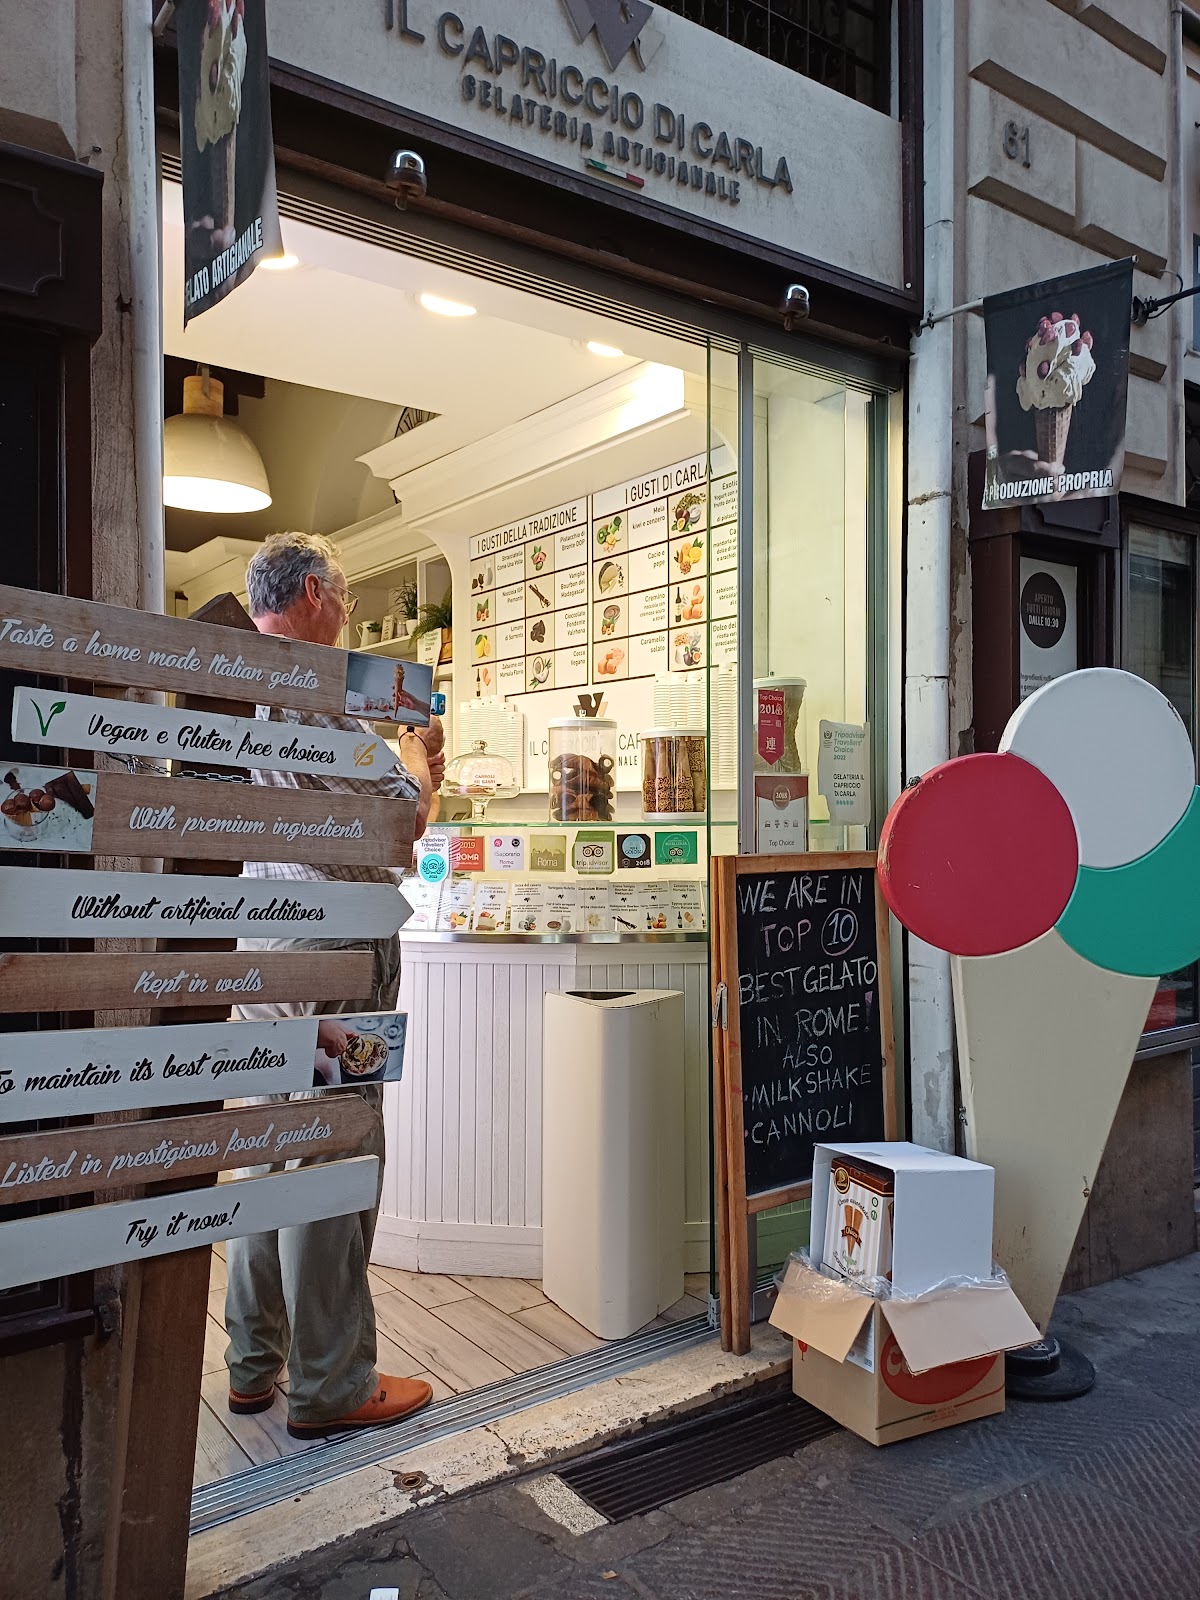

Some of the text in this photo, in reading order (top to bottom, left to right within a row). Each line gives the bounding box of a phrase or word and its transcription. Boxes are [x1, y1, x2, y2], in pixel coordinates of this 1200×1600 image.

[383, 0, 794, 194] IL CAPRICCIO DI CARLA
[462, 74, 741, 204] GELATERIA ARTIGIANALE
[185, 216, 263, 307] ELATO ARTIGIANALE
[630, 478, 659, 502] GUSTI
[662, 472, 673, 492] DI
[675, 462, 713, 486] CARLA
[1058, 469, 1113, 493] PROPRIA
[481, 533, 502, 552] GUSTI
[503, 525, 527, 545] DELLA
[529, 506, 577, 536] TRADIZIONE
[1028, 615, 1044, 626] DALLE
[0, 618, 320, 691] Taste a home made Italian gelato
[87, 713, 337, 765] Vegan e Gluten free choices
[529, 740, 539, 756] IL
[833, 773, 860, 781] GELATERIA
[129, 806, 365, 841] With premium ingredients
[769, 839, 778, 847] Top
[456, 853, 479, 861] ROMA
[460, 841, 475, 849] 2019
[537, 857, 558, 867] Roma
[71, 893, 326, 926] Without artificial additives
[738, 879, 777, 914] WE
[785, 875, 829, 909] ARE
[841, 875, 863, 904] IN
[760, 912, 855, 957] TOP 10
[133, 967, 264, 999] Kept in wells
[738, 955, 878, 1005] BEST GELATO
[756, 1014, 783, 1048] IN
[23, 1062, 122, 1092] maintain
[129, 1057, 153, 1083] its
[162, 1052, 211, 1080] best
[210, 1046, 288, 1081] qualities
[782, 1045, 833, 1069] ALSO
[751, 1101, 852, 1145] CANNOLI
[1, 1116, 333, 1188] Listed in prestigious food guides
[124, 1201, 241, 1248] Try it now!
